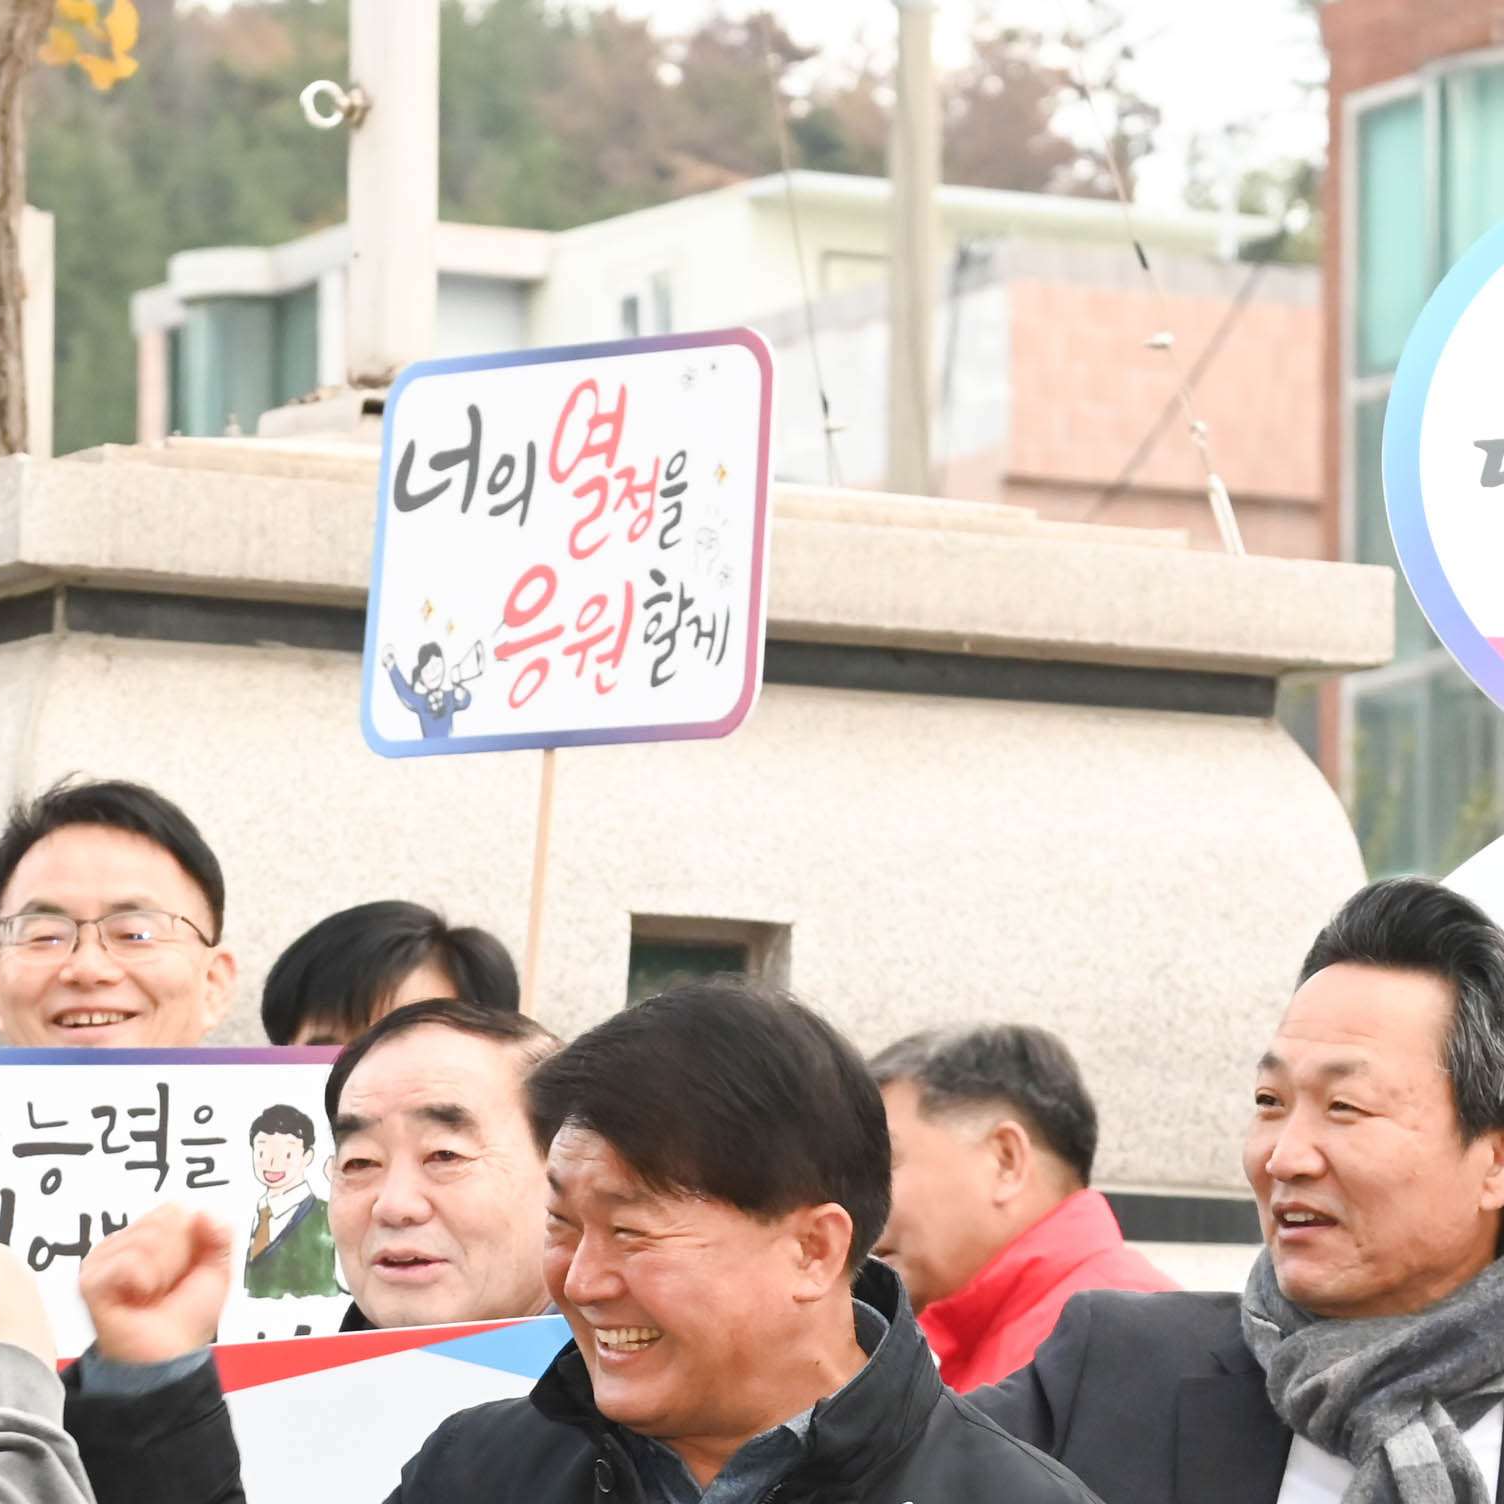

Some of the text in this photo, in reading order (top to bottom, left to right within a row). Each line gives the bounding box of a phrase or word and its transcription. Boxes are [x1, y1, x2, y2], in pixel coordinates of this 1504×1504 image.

[394, 377, 688, 561] 너의 열정을
[494, 563, 730, 710] 응원할게
